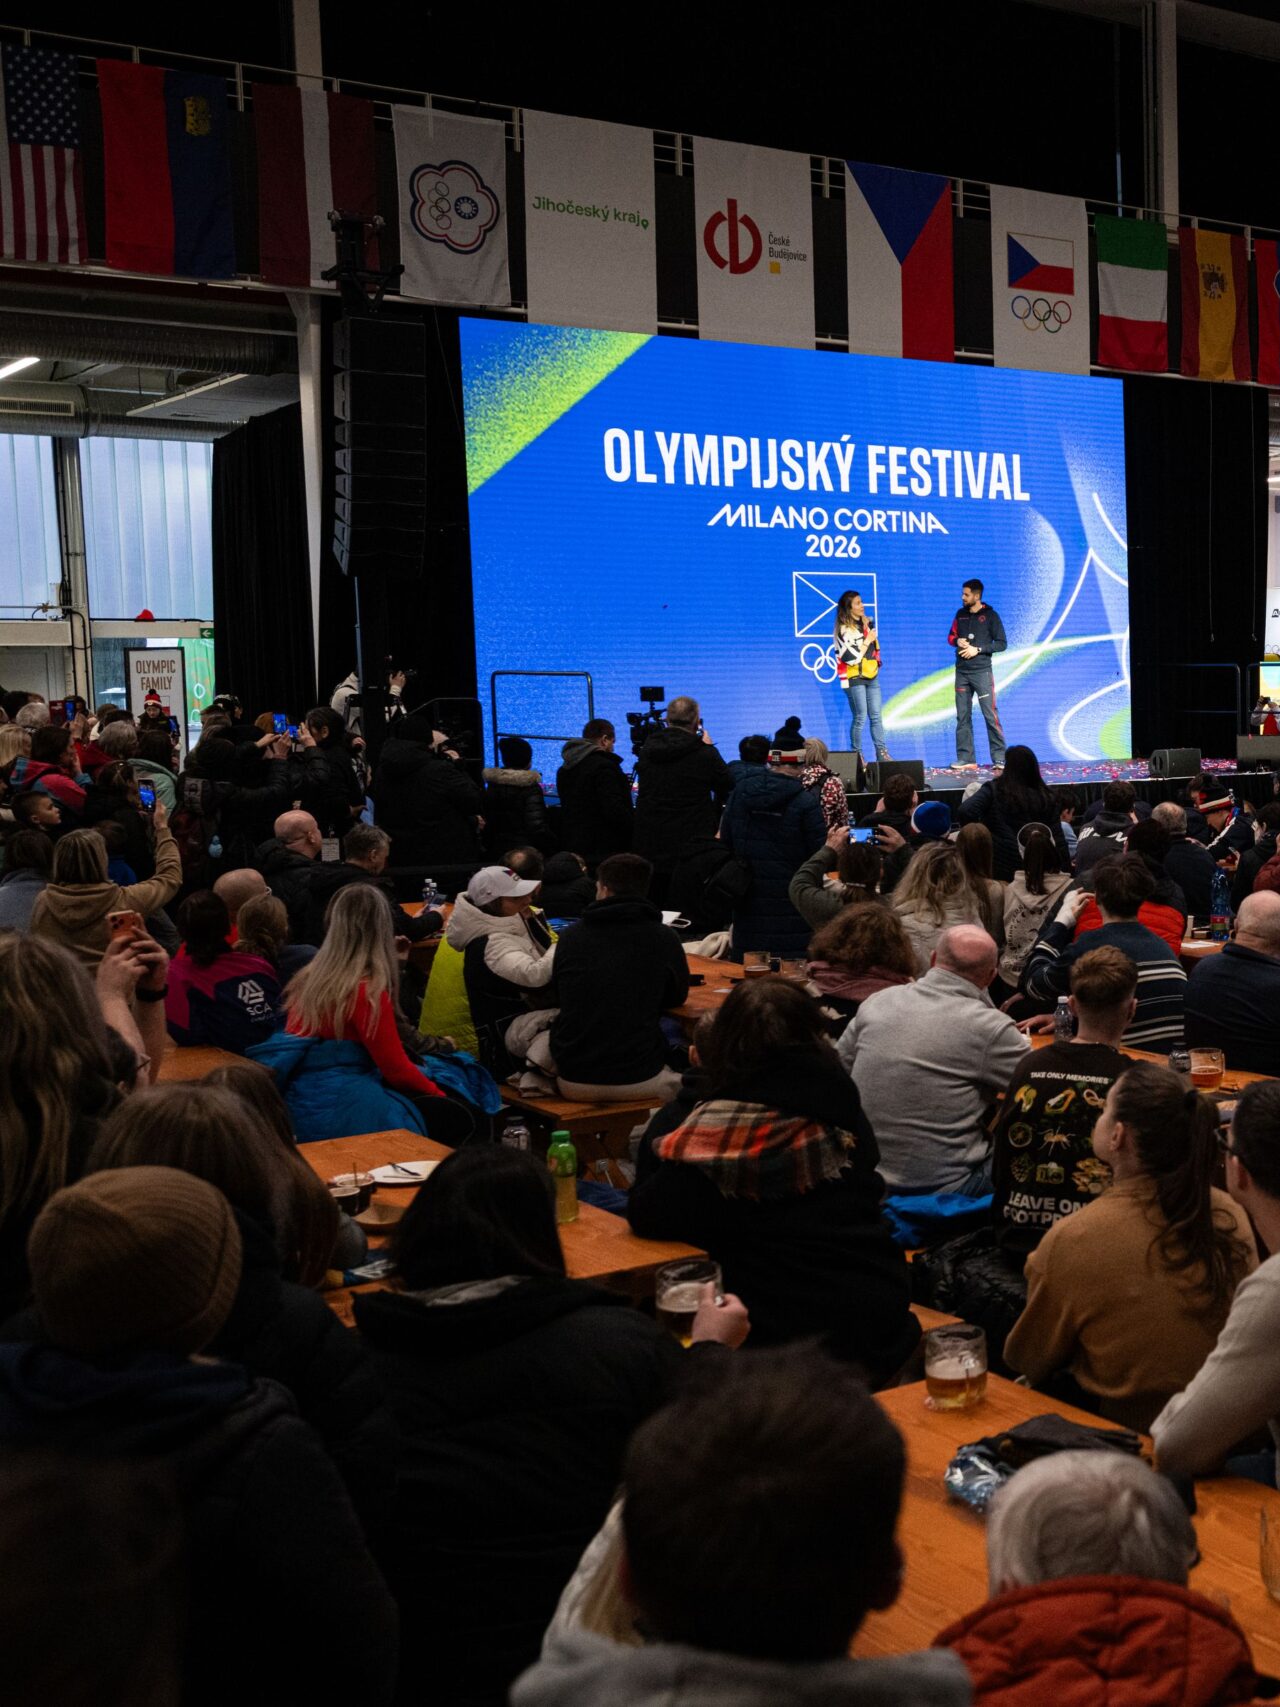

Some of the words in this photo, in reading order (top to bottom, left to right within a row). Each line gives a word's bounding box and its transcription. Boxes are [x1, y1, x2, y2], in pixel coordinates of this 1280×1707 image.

[532, 196, 610, 222] Jihočeský
[614, 207, 641, 227] kraj
[768, 231, 791, 247] České
[768, 247, 808, 262] Budějovice
[603, 427, 857, 493] OLYMPIJSKÝ
[867, 444, 1031, 501] FESTIVAL
[706, 503, 829, 530] MILANO
[833, 508, 950, 535] CORTINA
[805, 534, 862, 559] 2026
[135, 659, 176, 674] OLYMPIC
[140, 676, 173, 691] FAMILY
[246, 1002, 272, 1016] SCA
[1030, 1071, 1047, 1079] TAKE
[1047, 1072, 1066, 1080] ONLY
[1066, 1073, 1110, 1085] MEMORIES
[1008, 1191, 1056, 1211] LEAVE
[1058, 1198, 1087, 1214] ON
